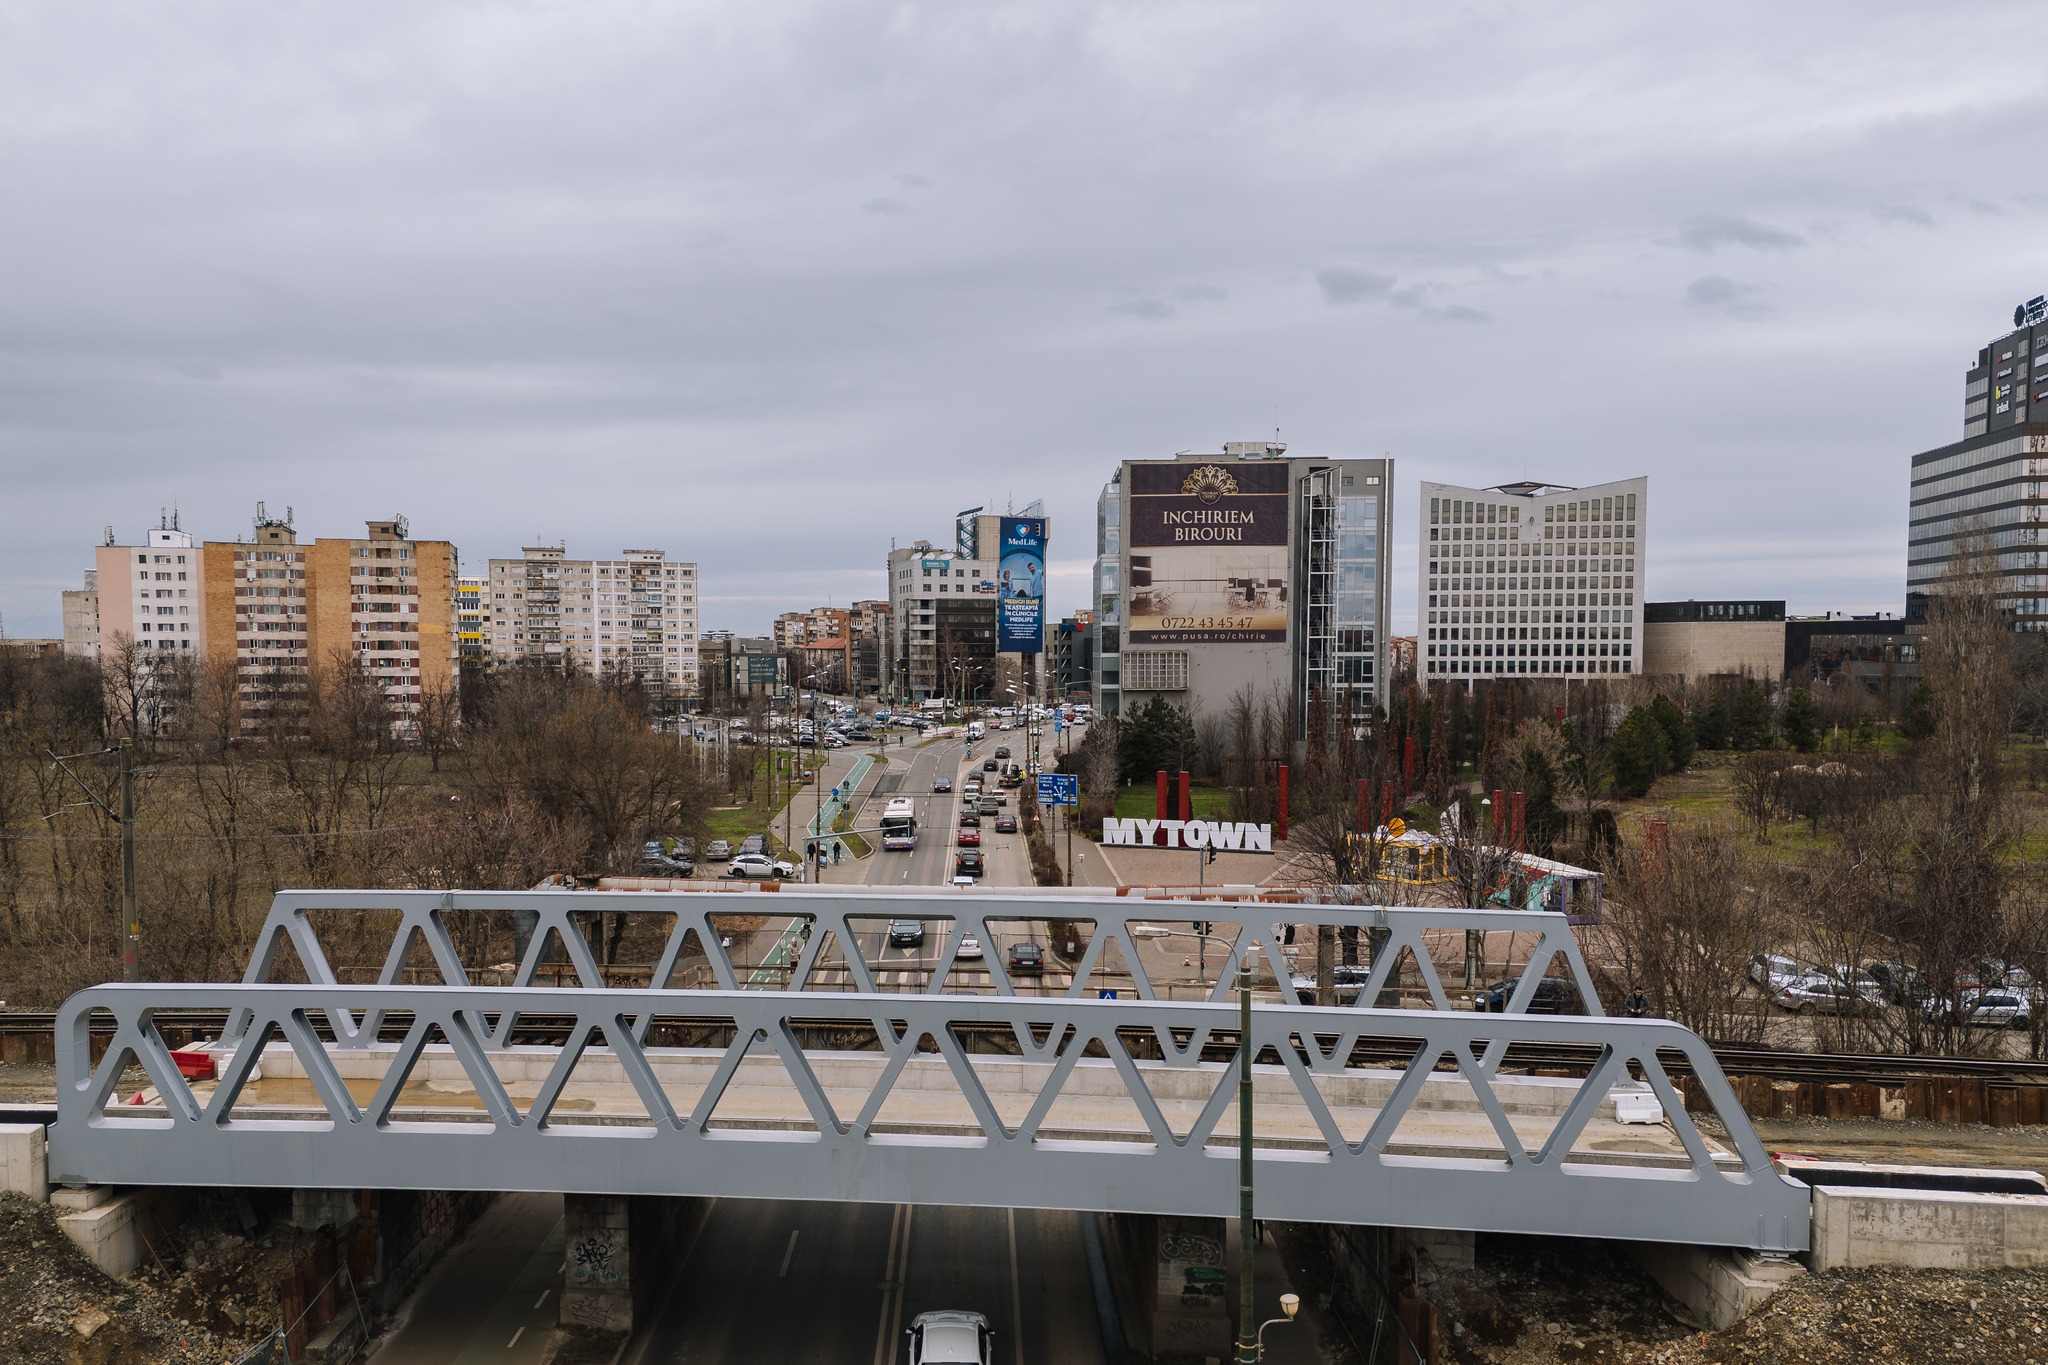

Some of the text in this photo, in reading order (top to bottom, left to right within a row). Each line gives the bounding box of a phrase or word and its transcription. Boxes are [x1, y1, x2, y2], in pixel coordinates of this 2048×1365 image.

[1163, 510, 1255, 524] INCHIRIEM
[1175, 527, 1243, 541] BIROURI
[1008, 538, 1038, 546] MedLife
[1161, 617, 1254, 628] 0722 43 45 47
[1151, 632, 1266, 640] www.pusa.ro/chirie
